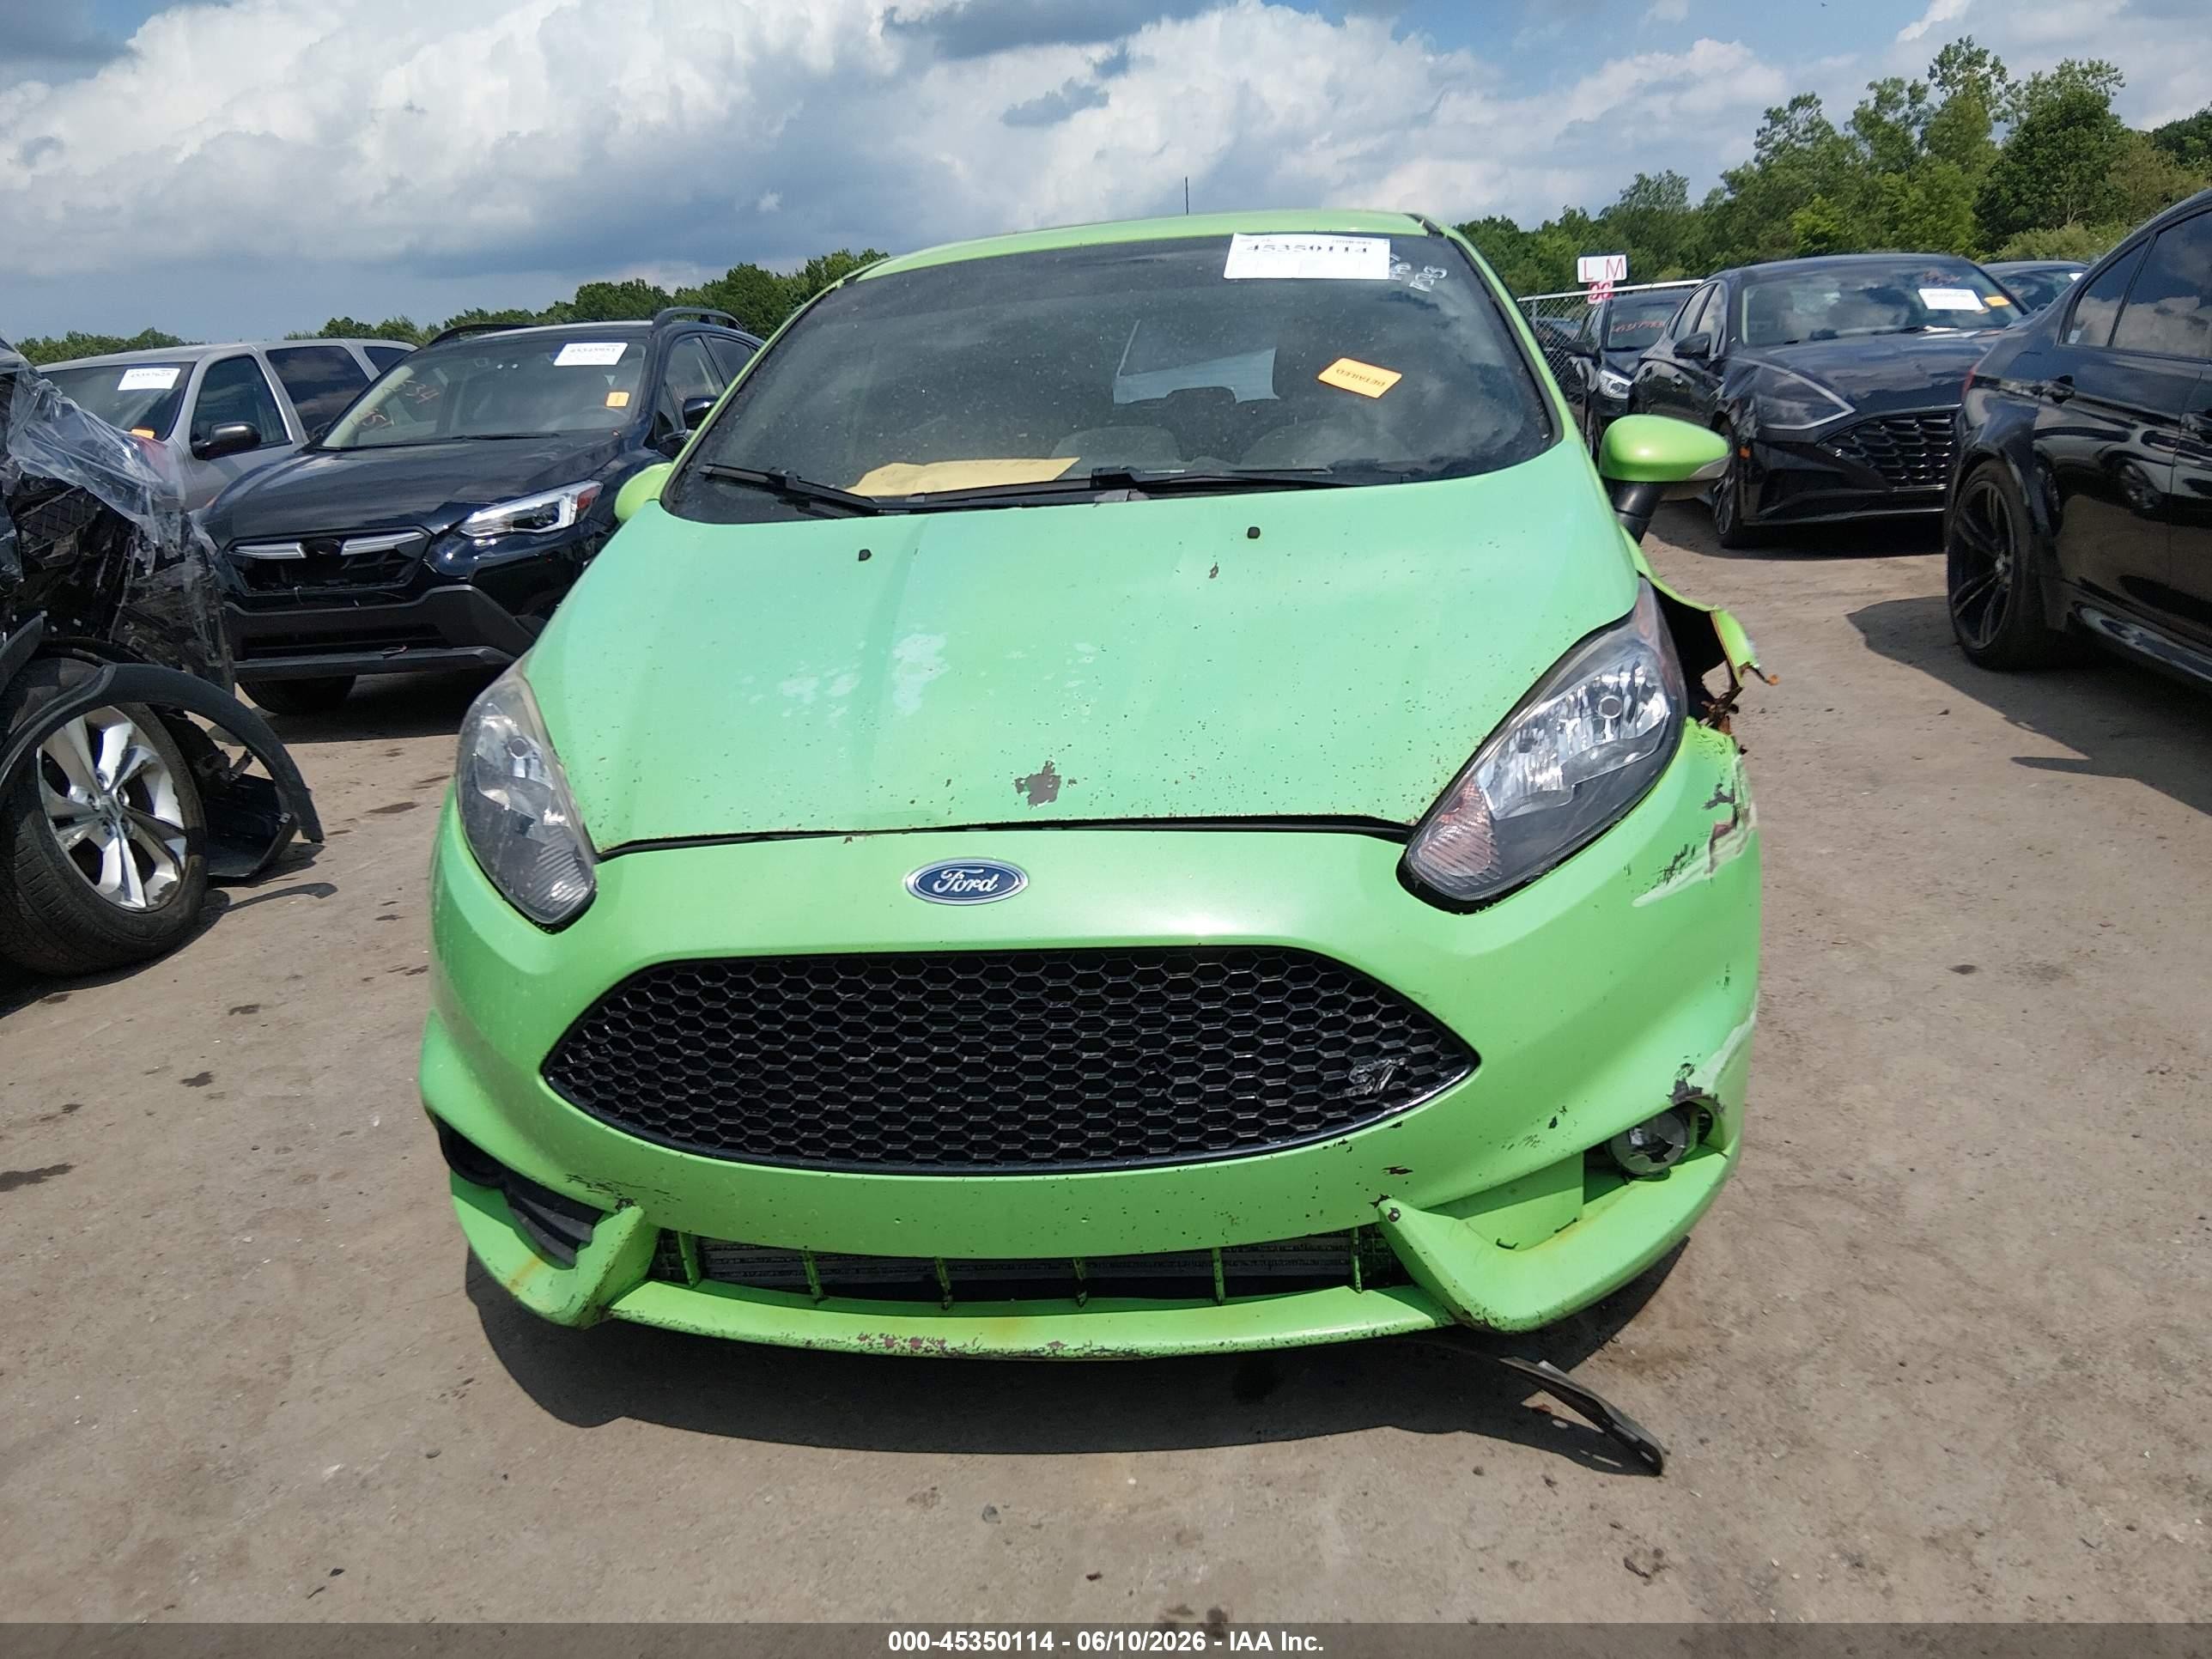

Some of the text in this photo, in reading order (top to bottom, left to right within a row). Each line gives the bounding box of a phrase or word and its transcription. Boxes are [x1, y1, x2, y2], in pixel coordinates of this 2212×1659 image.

[1247, 244, 1368, 255] 45350114
[1583, 257, 1625, 281] L M
[933, 868, 1000, 893] Ford
